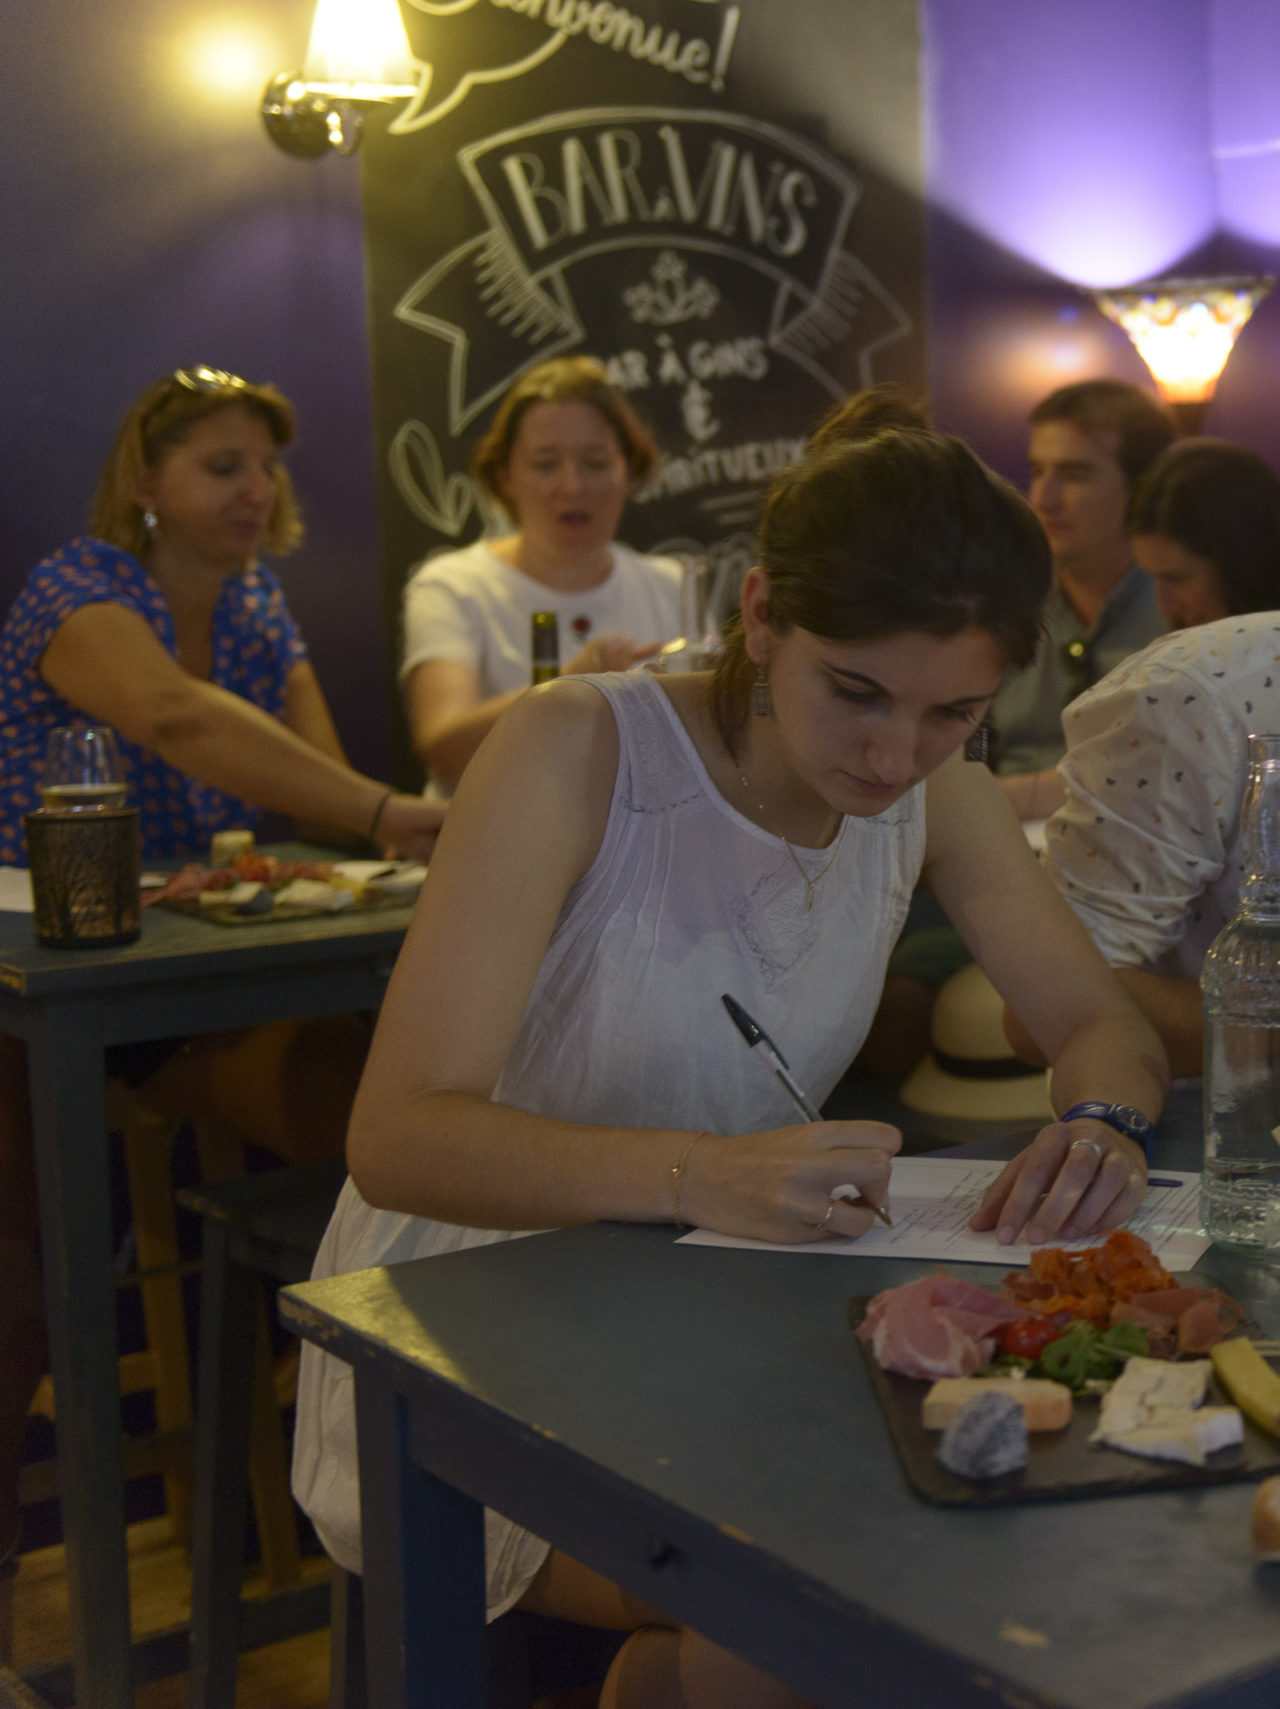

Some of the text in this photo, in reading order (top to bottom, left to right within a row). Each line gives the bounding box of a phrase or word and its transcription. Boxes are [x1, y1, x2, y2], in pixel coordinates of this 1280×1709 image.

[502, 129, 651, 250] BAR
[656, 124, 818, 257] VINS
[604, 351, 650, 391] AR
